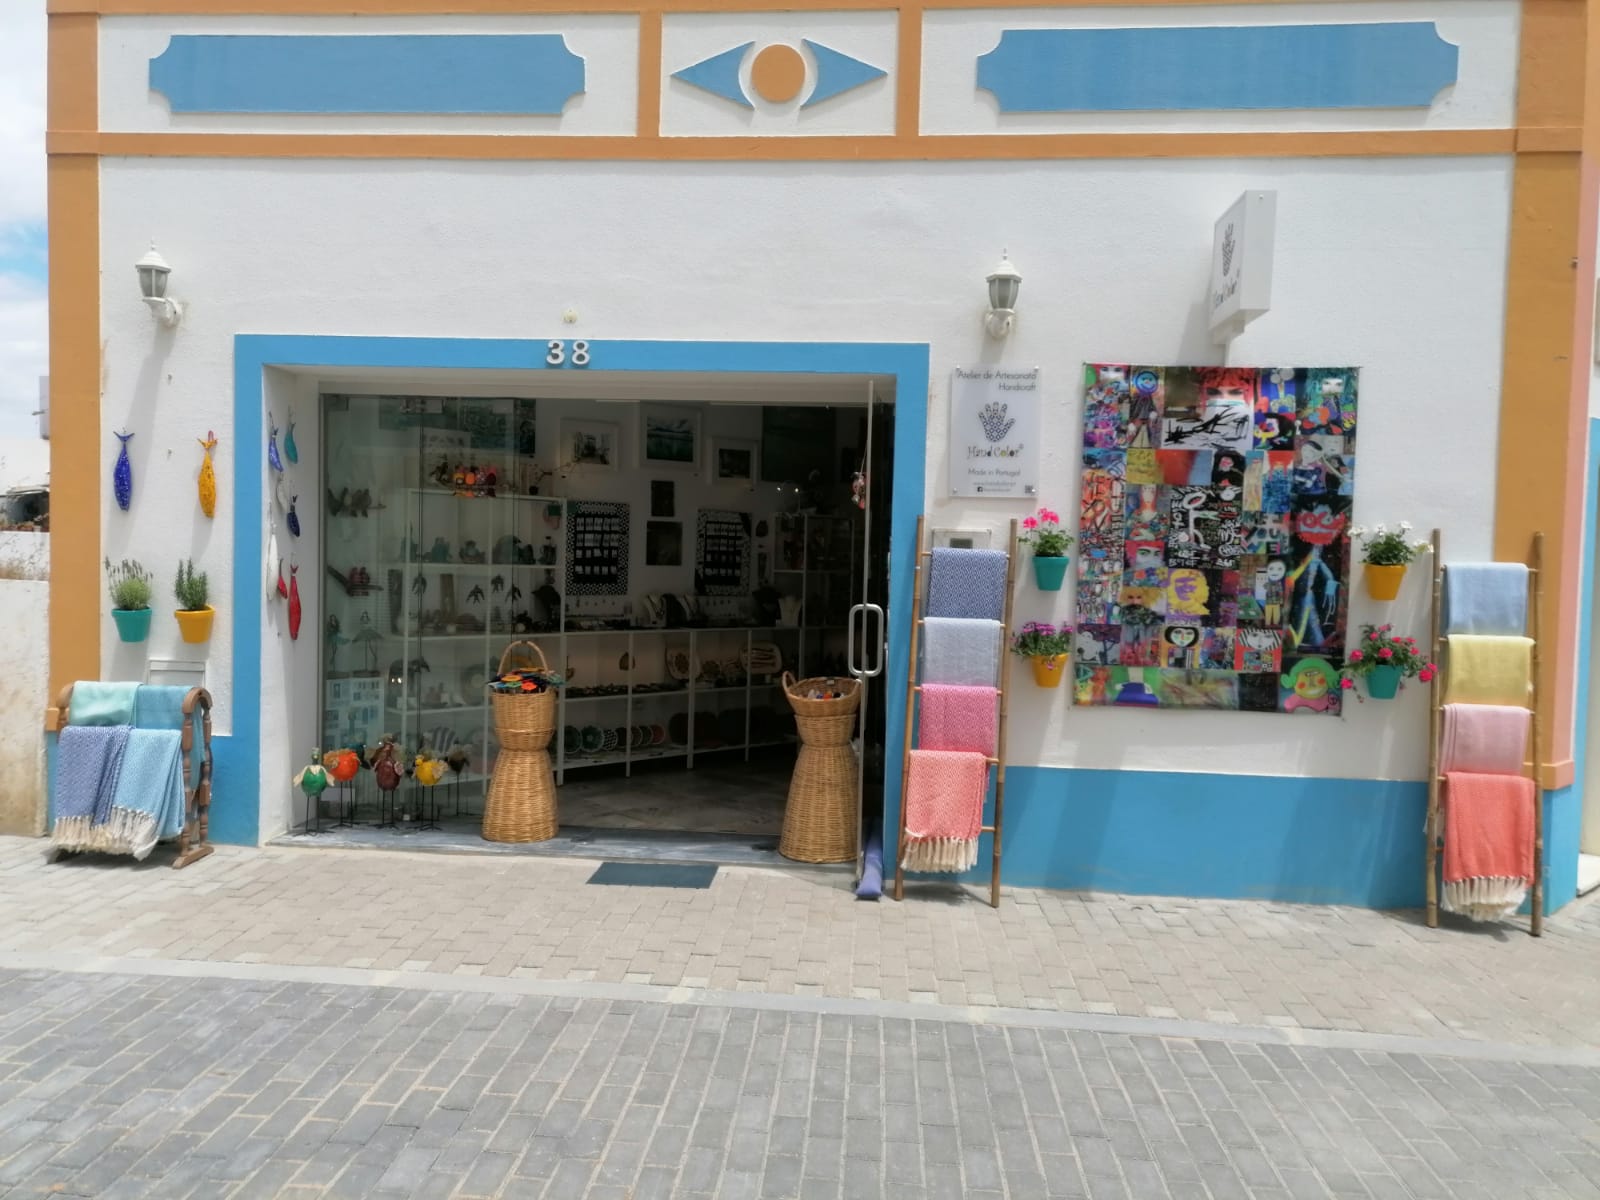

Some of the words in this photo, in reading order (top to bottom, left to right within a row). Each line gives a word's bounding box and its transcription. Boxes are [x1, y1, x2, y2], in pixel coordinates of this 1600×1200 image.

[546, 340, 590, 365] 38
[958, 370, 982, 380] Atelier
[983, 370, 993, 380] de
[995, 370, 1037, 380] Artesanato
[995, 468, 1021, 477] Portugal
